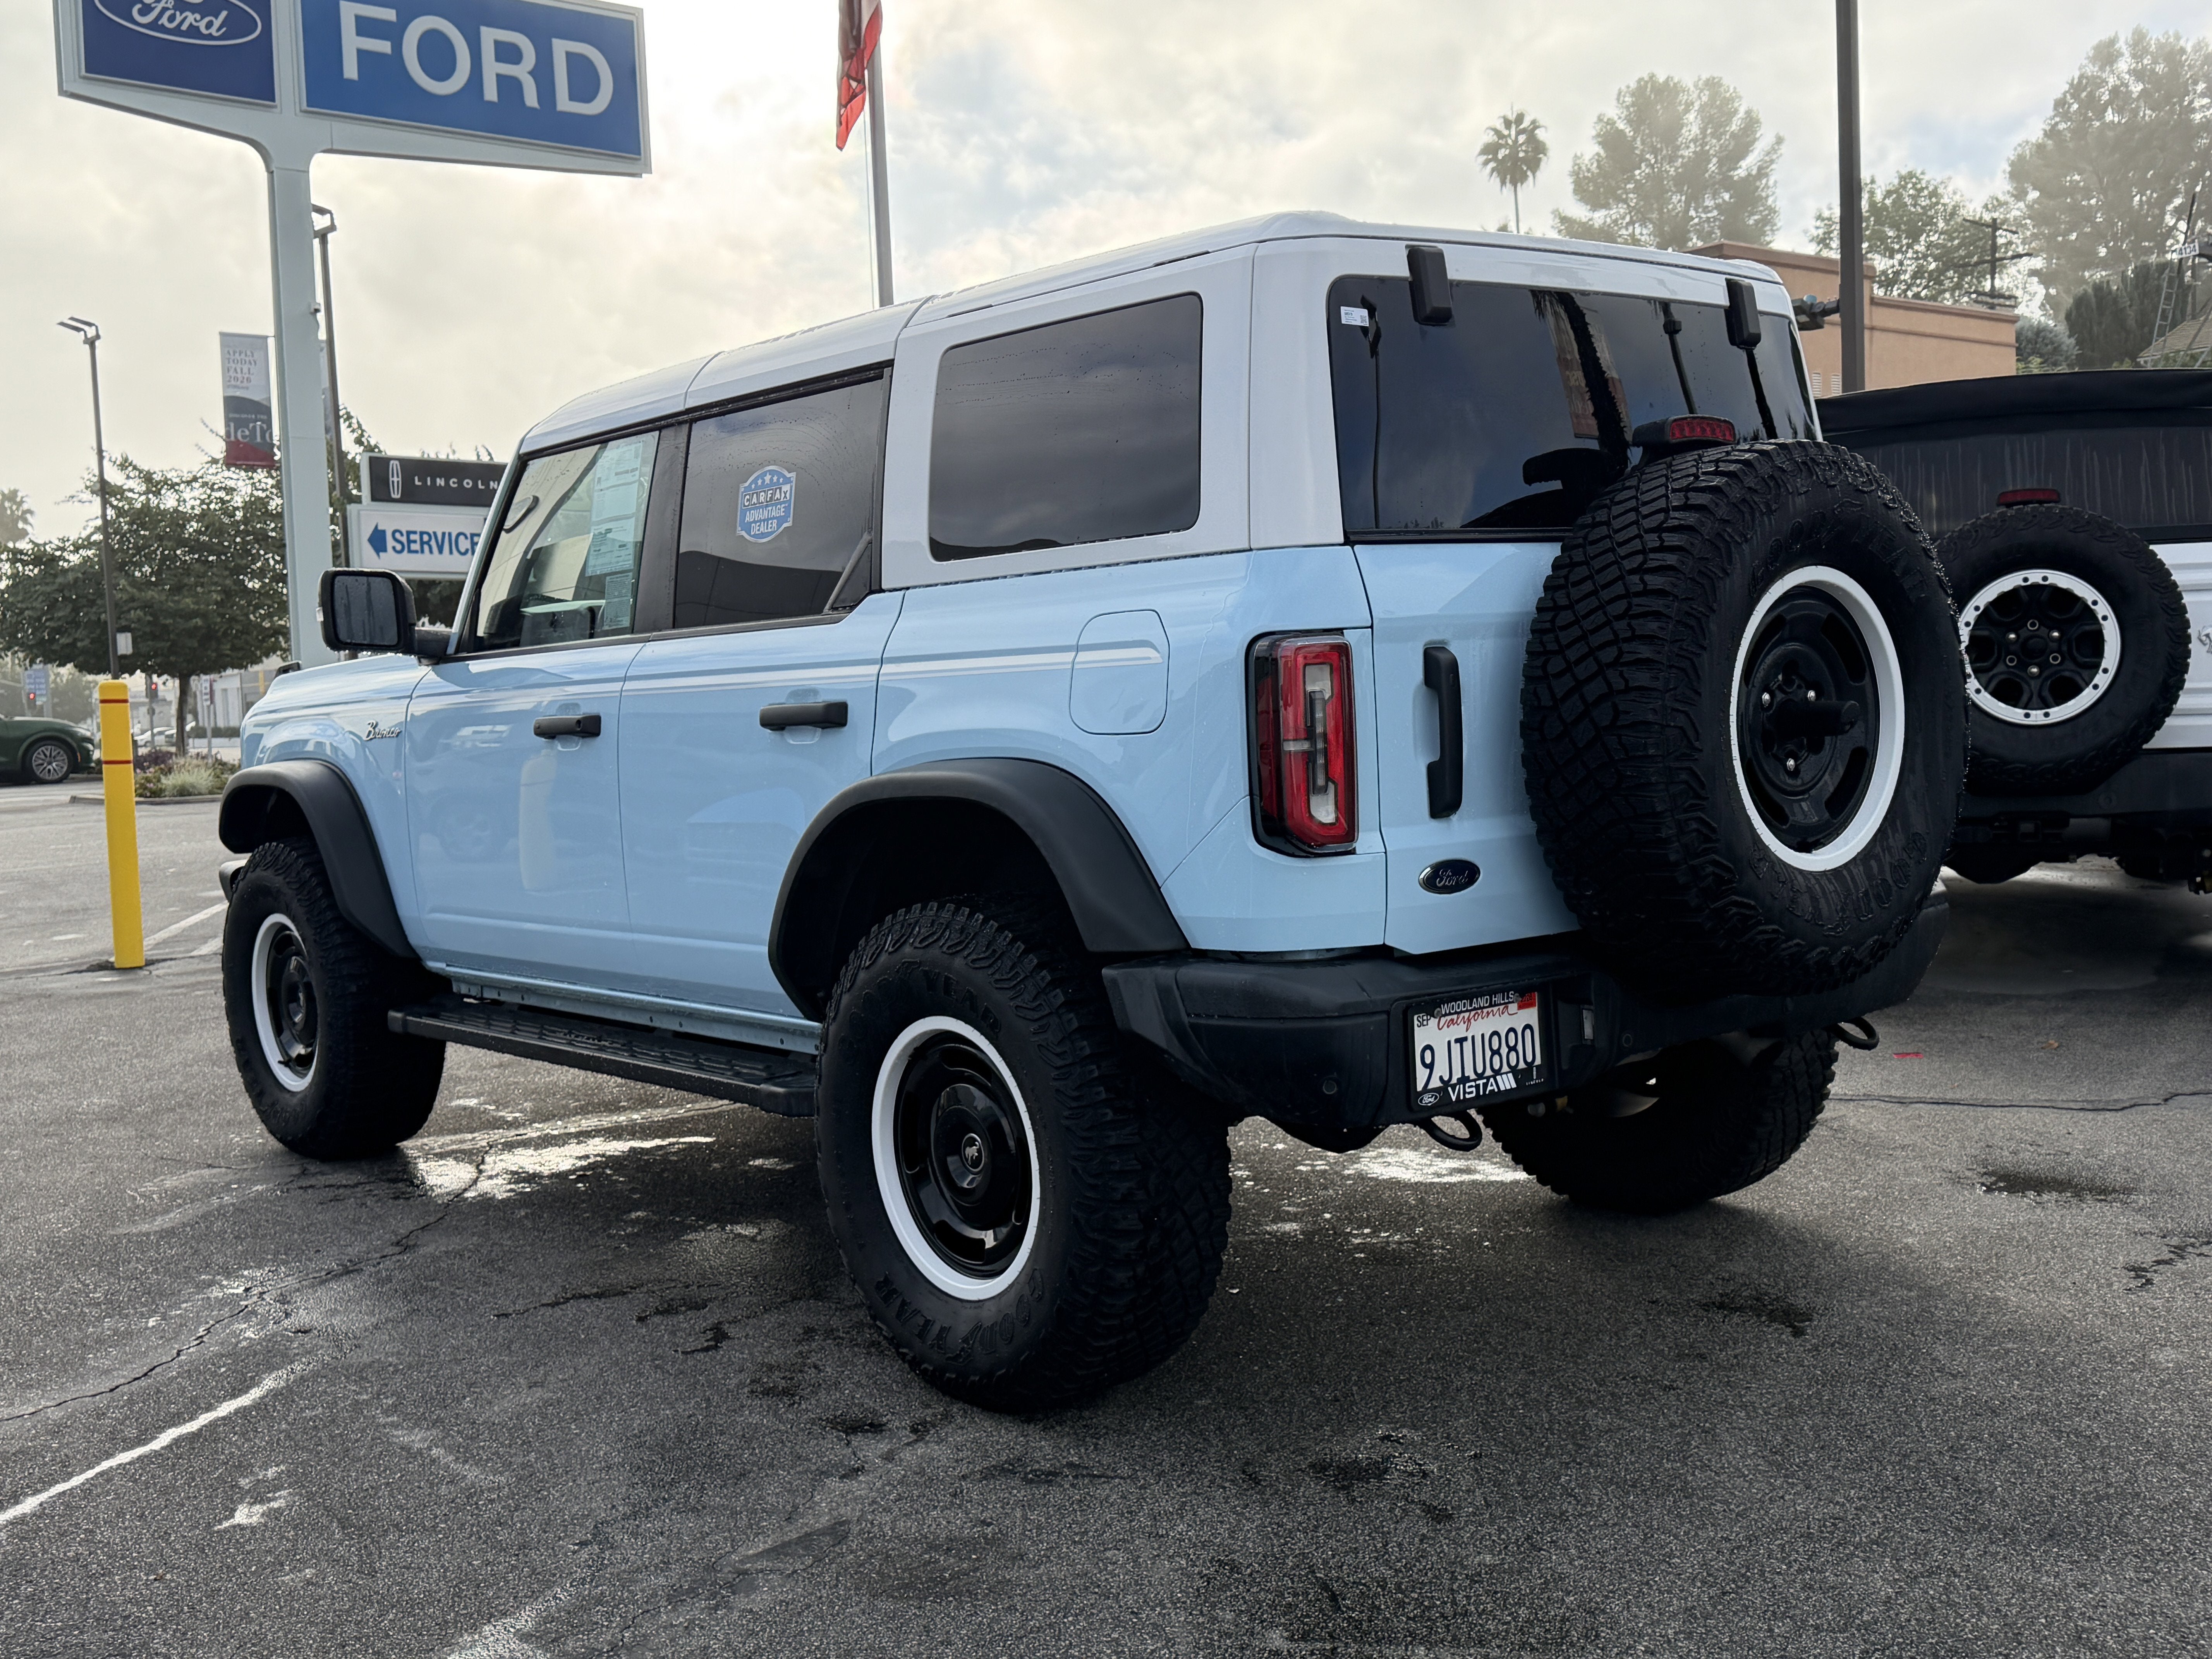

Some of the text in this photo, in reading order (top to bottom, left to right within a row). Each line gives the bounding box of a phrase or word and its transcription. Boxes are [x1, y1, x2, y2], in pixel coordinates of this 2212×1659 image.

[132, 0, 228, 37] Ford
[339, 0, 614, 116] FORD
[226, 357, 257, 366] TODAY
[227, 349, 254, 357] APPLY
[227, 366, 254, 375] FALL
[415, 476, 498, 490] LINCOLN
[744, 488, 789, 506] CARFAX
[745, 505, 785, 522] ADVANTAGE
[751, 519, 777, 535] DEALER
[364, 720, 402, 741] Bronco
[1436, 869, 1468, 887] Ford
[1441, 996, 1489, 1014] WOODLAND
[1492, 991, 1515, 1005] HILLS
[1416, 1014, 1431, 1028] SEP
[1448, 1077, 1498, 1102] VISTA
[1422, 1094, 1435, 1103] Ford
